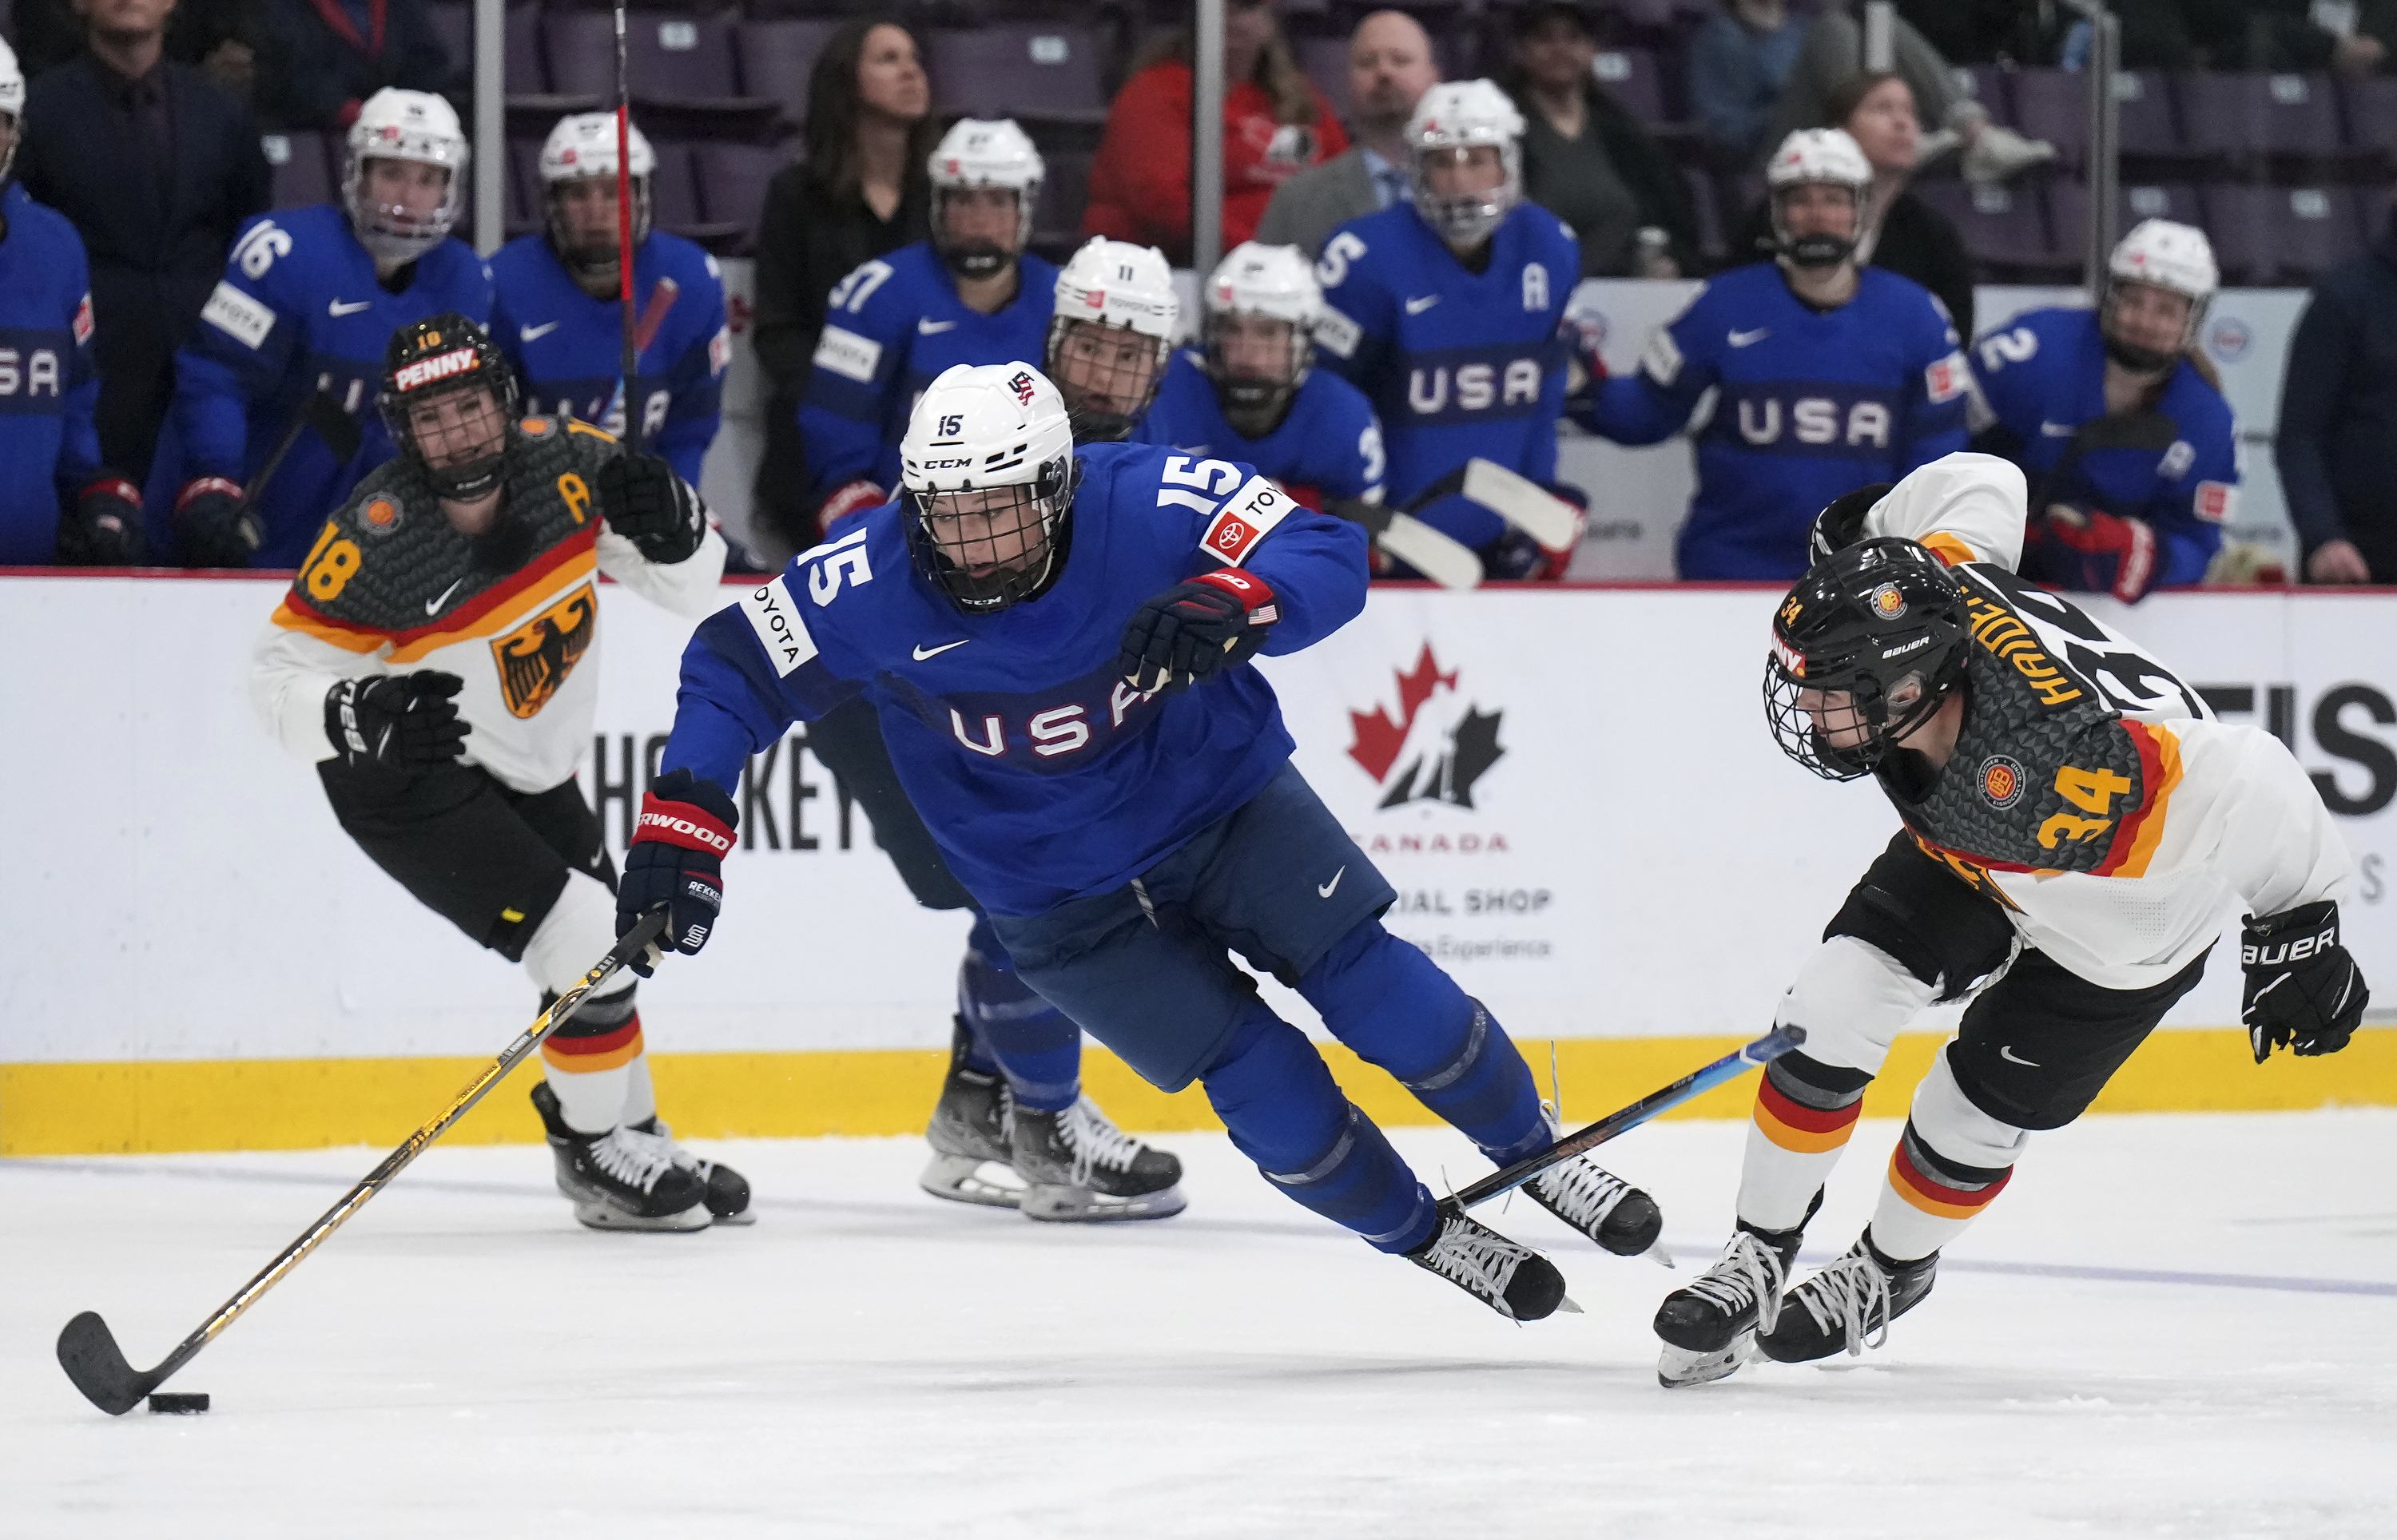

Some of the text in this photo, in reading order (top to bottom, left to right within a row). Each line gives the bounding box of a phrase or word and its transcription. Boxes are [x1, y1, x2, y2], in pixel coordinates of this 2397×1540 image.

[229, 219, 293, 280] 16
[1119, 265, 1133, 281] 11
[1314, 230, 1367, 288] 5
[1521, 262, 1550, 312] A
[1979, 327, 2039, 373] 2
[1408, 359, 1541, 414] USA
[937, 415, 964, 436] 15
[1737, 398, 1893, 449] USA
[924, 458, 972, 470] CCM
[1156, 456, 1242, 515] 15
[558, 472, 591, 524] A
[298, 520, 362, 601] 18
[797, 526, 873, 608] 15
[1781, 596, 1803, 625] 34
[950, 681, 1153, 756] USA
[2037, 764, 2132, 849] 34
[1464, 887, 1553, 916] SHOP
